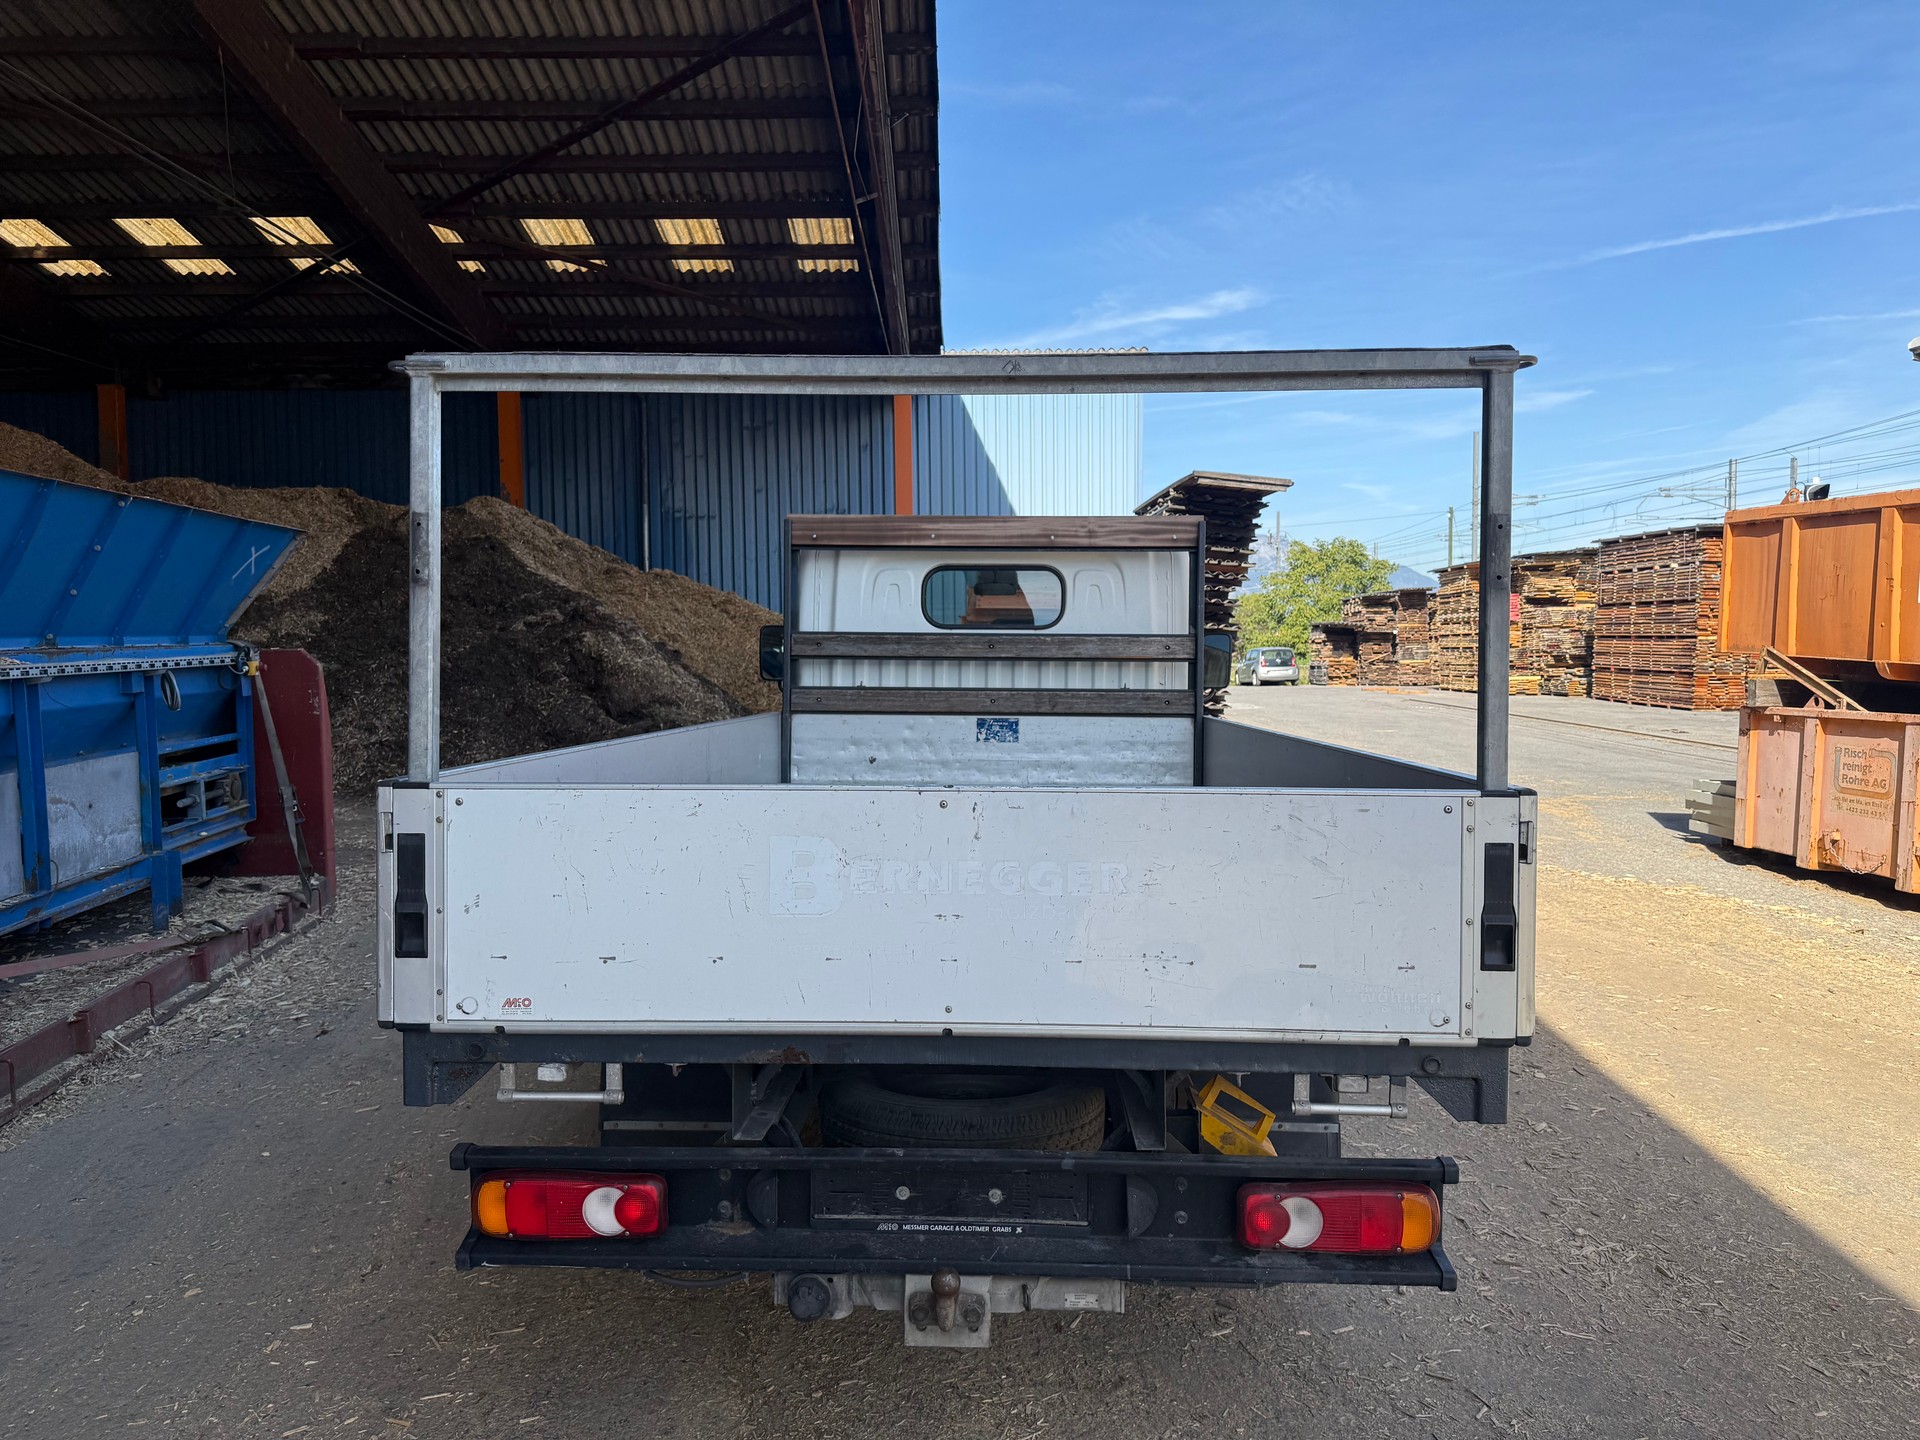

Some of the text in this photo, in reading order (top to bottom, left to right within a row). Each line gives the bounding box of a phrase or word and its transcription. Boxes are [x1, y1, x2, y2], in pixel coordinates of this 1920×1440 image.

[1843, 747, 1867, 760] Risch
[1842, 762, 1872, 775] reinigt
[1841, 773, 1887, 790] Rohre AG
[768, 834, 1132, 918] BERNEGGER
[929, 1224, 954, 1232] GARAGE
